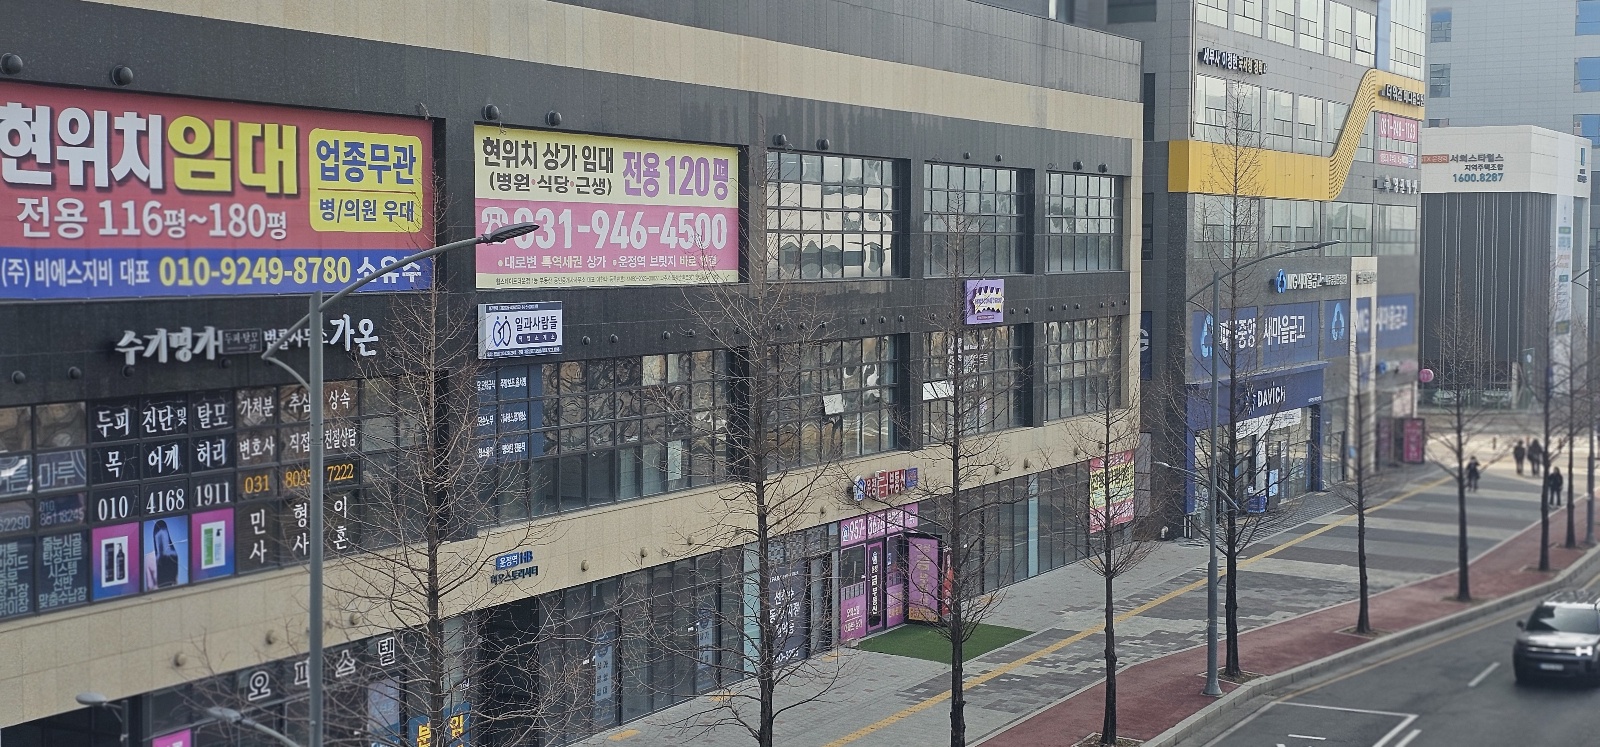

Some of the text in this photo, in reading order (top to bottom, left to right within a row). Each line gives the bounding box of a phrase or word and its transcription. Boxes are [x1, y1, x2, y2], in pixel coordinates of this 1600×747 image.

[315, 139, 416, 185] 업종무관
[482, 136, 614, 174] 현위치 상가 임대
[622, 151, 729, 201] 전용 120평
[1453, 172, 1504, 183] 1600.8287
[16, 196, 287, 240] 전용 116평~180평
[319, 197, 416, 225] 병/의원 우대
[513, 207, 728, 250] 031-946-4500
[1, 258, 31, 288] (주)
[35, 258, 113, 288] 비에스지비
[120, 259, 150, 285] 대표
[159, 255, 351, 287] 010-9249-8780
[504, 255, 537, 270] 대로변
[586, 255, 606, 269] 상가
[618, 254, 647, 269] 운정역
[649, 254, 676, 268] 브릿지
[679, 254, 697, 268] 바로
[330, 313, 379, 356] 가온
[514, 315, 558, 332] 일과사람들
[1263, 315, 1306, 346] 새마을금고
[114, 325, 223, 366] 수기명가
[240, 396, 274, 419] 가처분
[328, 389, 351, 411] 상속
[1257, 382, 1286, 408] DAVICH
[97, 408, 130, 438] 두피
[197, 403, 228, 430] 탈모
[105, 450, 123, 479] 목
[197, 438, 227, 468] 허리
[239, 427, 357, 461] 변호사 직접 친절상담
[38, 460, 76, 487] 마루
[244, 474, 270, 494] 031
[327, 463, 354, 483] 7222
[98, 482, 230, 521] 010 4168 1911
[249, 508, 267, 564] 민사
[292, 502, 310, 556] 형사
[333, 496, 349, 551] 이혼
[43, 533, 82, 553] 줄눈시공
[43, 546, 82, 567] 탄성코트
[48, 562, 77, 580] 시스템
[53, 576, 73, 592] 선반
[39, 587, 87, 610] 맞춤수납장
